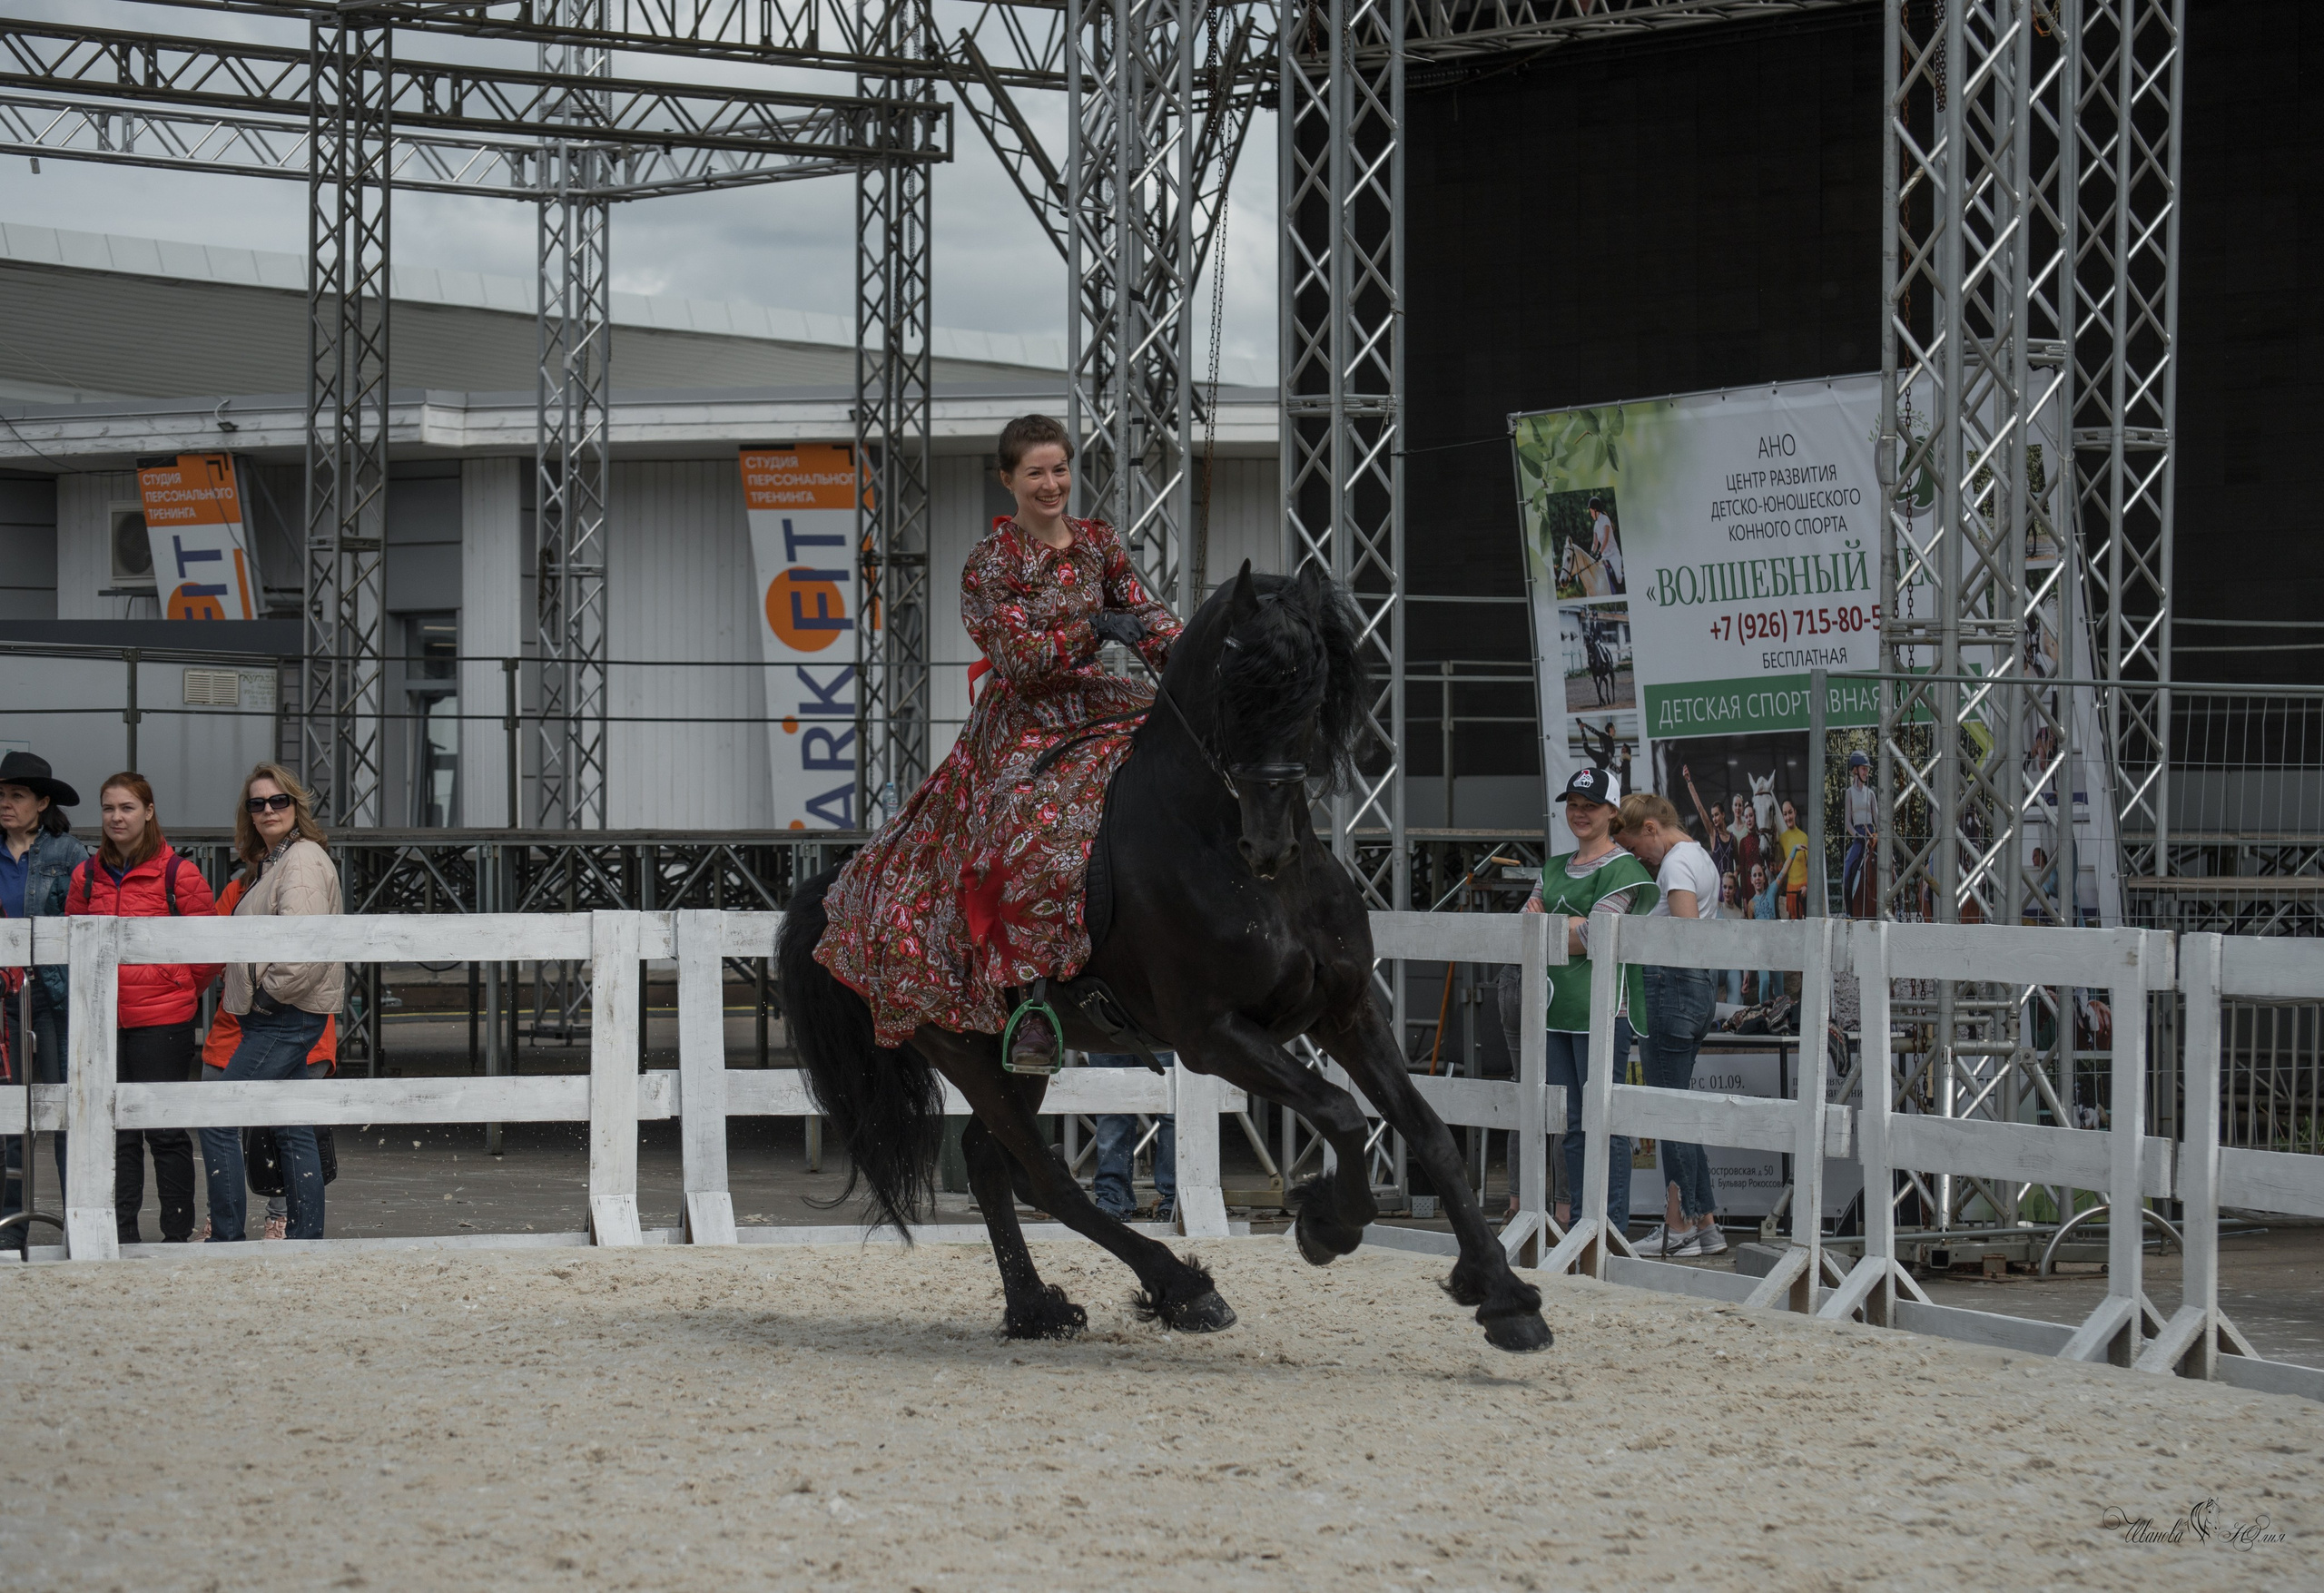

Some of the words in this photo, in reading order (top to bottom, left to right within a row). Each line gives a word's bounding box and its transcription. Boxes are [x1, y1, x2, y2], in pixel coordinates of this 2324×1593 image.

[1758, 433, 1796, 459] АНО
[745, 456, 799, 471] СТУДИЯ
[143, 472, 182, 487] СТУДИЯ
[747, 472, 866, 487] ПЕРСОНАЛЬНОГ
[1726, 470, 1767, 494] ЦЕНТР
[1770, 464, 1837, 487] РАЗВИТИЯ
[145, 487, 233, 503] ПЕРСОНАЛЬНОГО
[750, 490, 815, 504] ТРЕНИНГА
[1711, 487, 1861, 522] ДЕТСКО-ЮНОШЕСКОГО
[148, 506, 196, 520] ТРЕНИНГА
[1728, 519, 1791, 542] КОННОГО
[1794, 515, 1848, 536] СПОРТА
[1710, 615, 1732, 641] +7
[1737, 609, 1788, 646] (926)
[1792, 604, 1881, 636] 715-80-5
[1762, 646, 1847, 670] БЕСПЛАТНАЯ
[1658, 693, 1741, 730] ДЕТСКАЯ
[1747, 685, 1881, 720] СПОРТВНАЯ
[1709, 1075, 1746, 1089] 01.09.
[1764, 1165, 1774, 1176] 50
[1718, 1177, 1747, 1189] Бульвар
